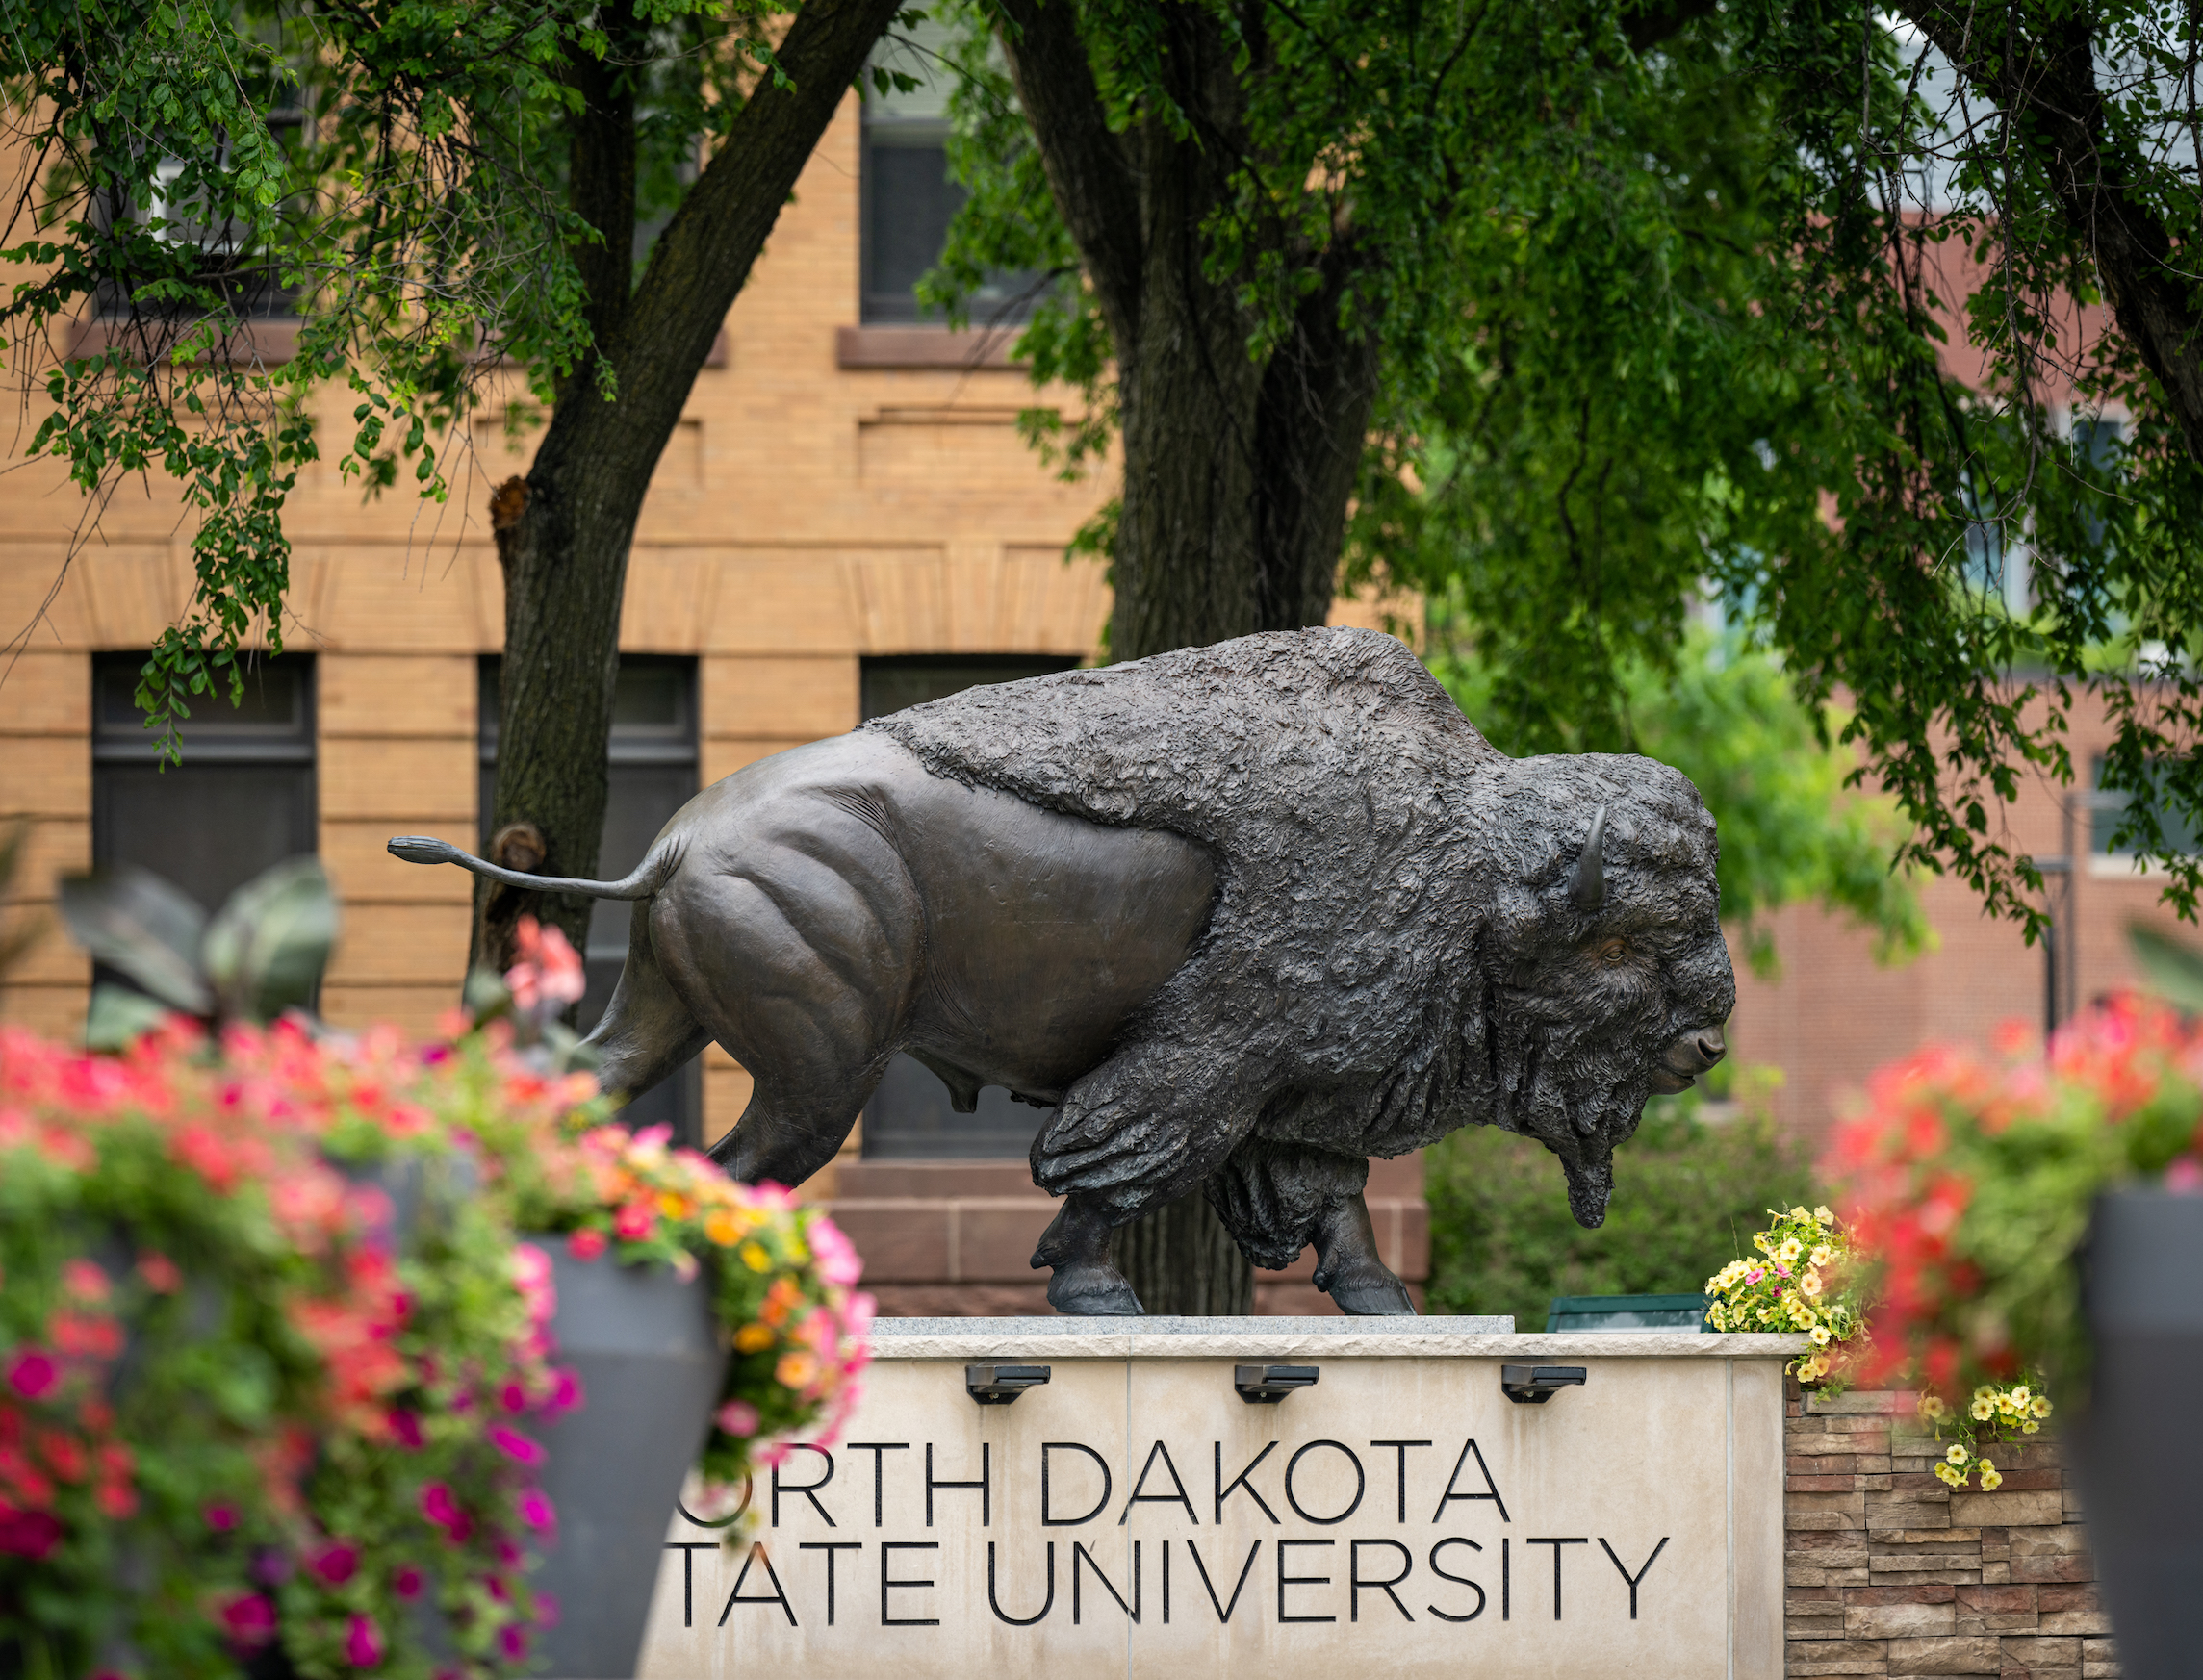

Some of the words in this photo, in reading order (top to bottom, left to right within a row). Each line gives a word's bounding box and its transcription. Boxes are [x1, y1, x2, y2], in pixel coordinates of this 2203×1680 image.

[675, 1442, 989, 1528] ORTH
[1042, 1439, 1510, 1527] DAKOTA
[664, 1541, 939, 1627] TATE
[987, 1537, 1670, 1626] UNIVERSITY
